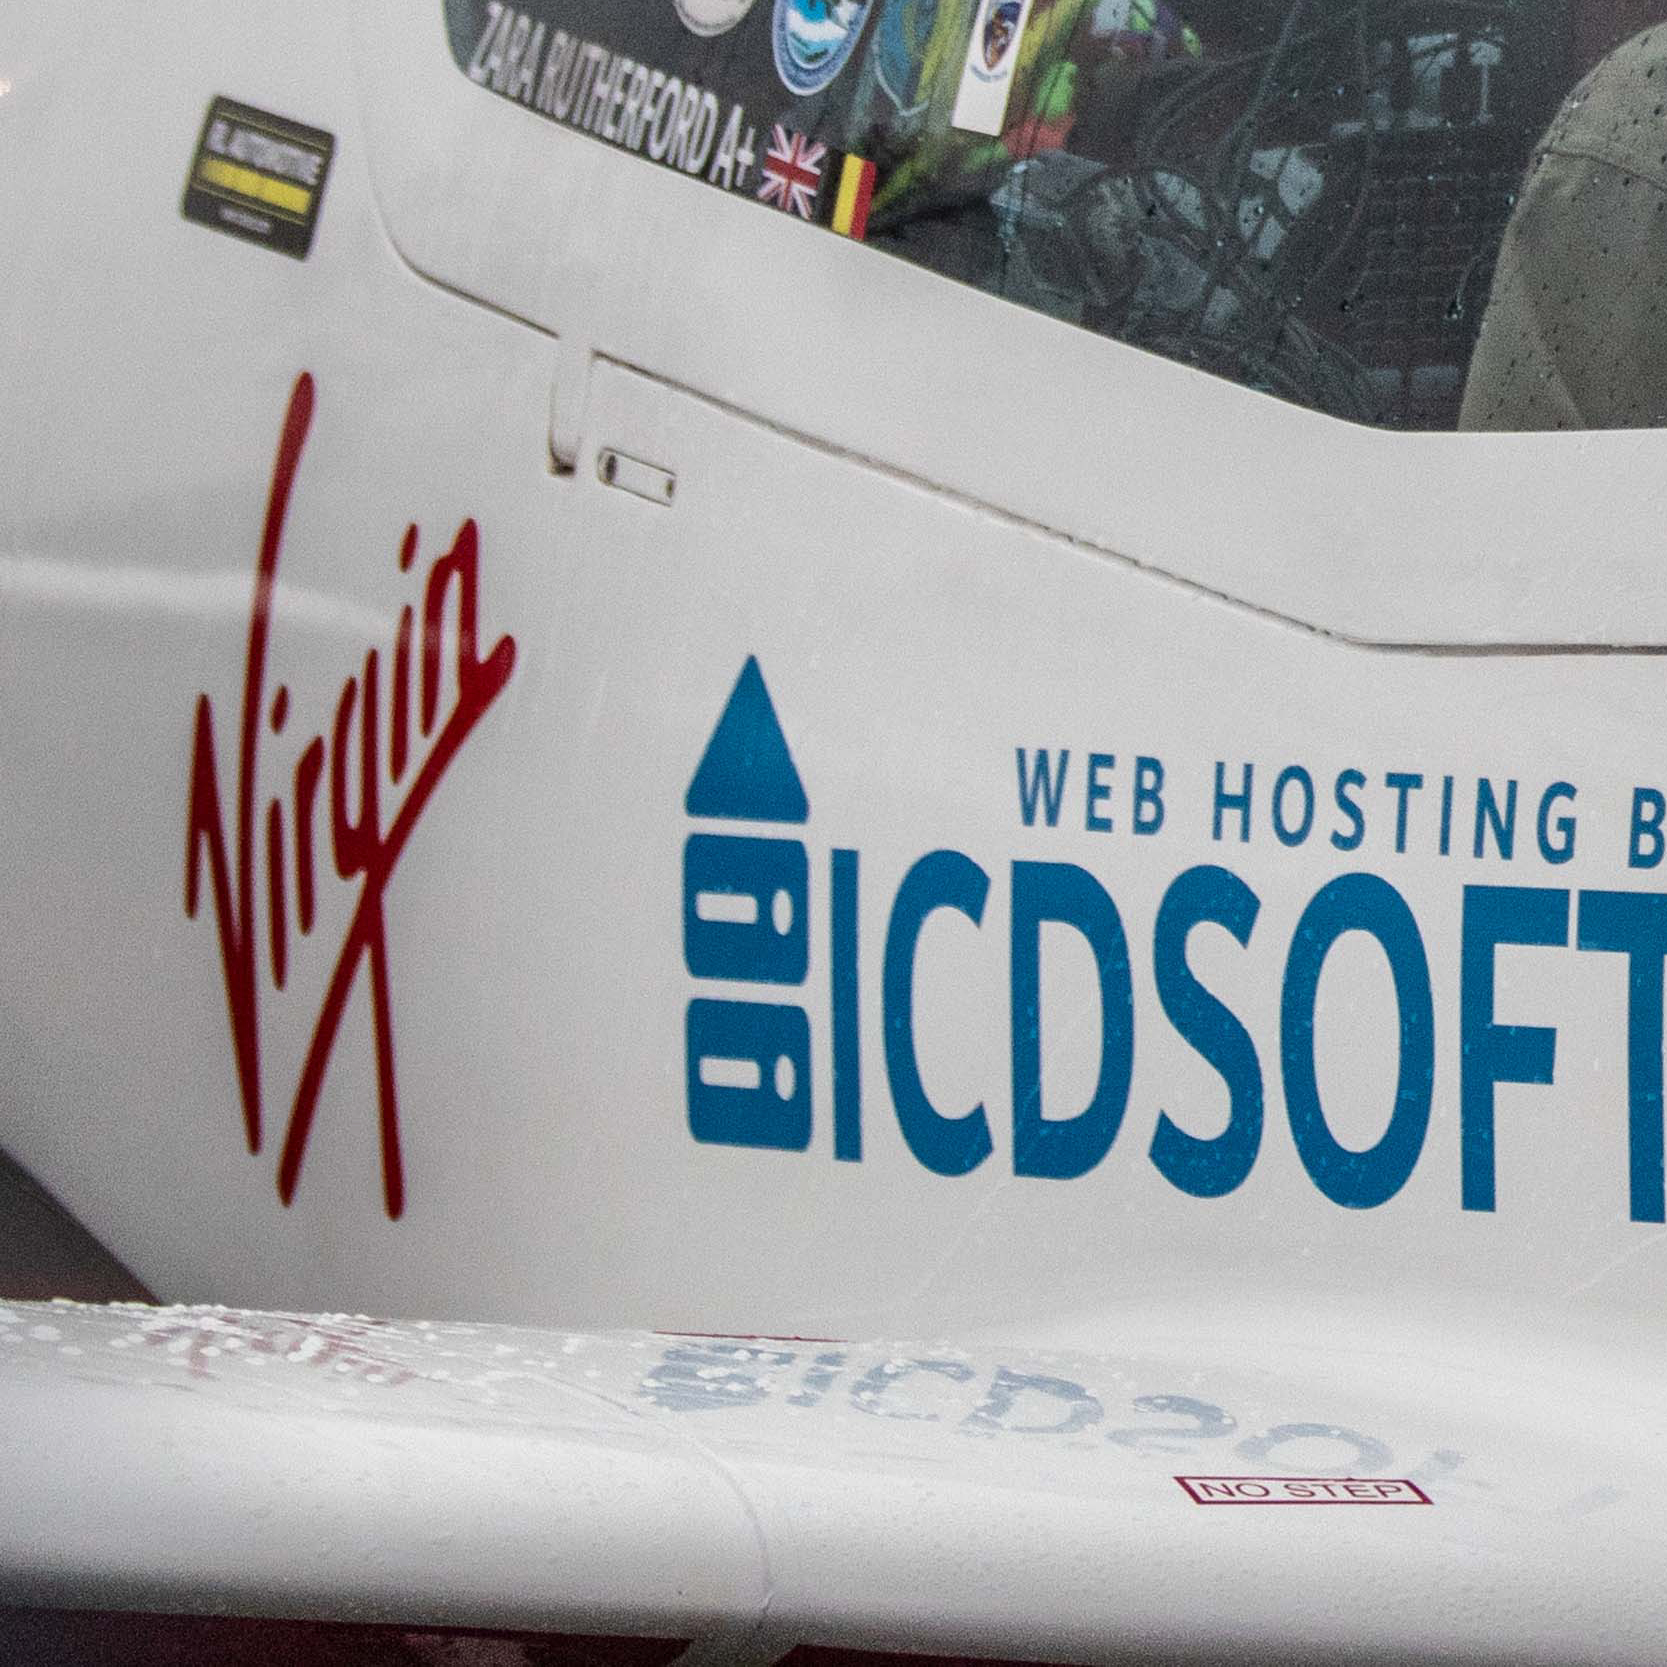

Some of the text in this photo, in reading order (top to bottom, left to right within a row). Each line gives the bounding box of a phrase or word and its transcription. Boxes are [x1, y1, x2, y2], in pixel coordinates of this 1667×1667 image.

[470, 0, 755, 190] ZARA RUTHERFORD A+
[184, 371, 518, 1222] Virgin
[1014, 746, 1166, 837] WEB
[1211, 762, 1580, 867] HOSTING
[1198, 1481, 1404, 1500] NO STEP
